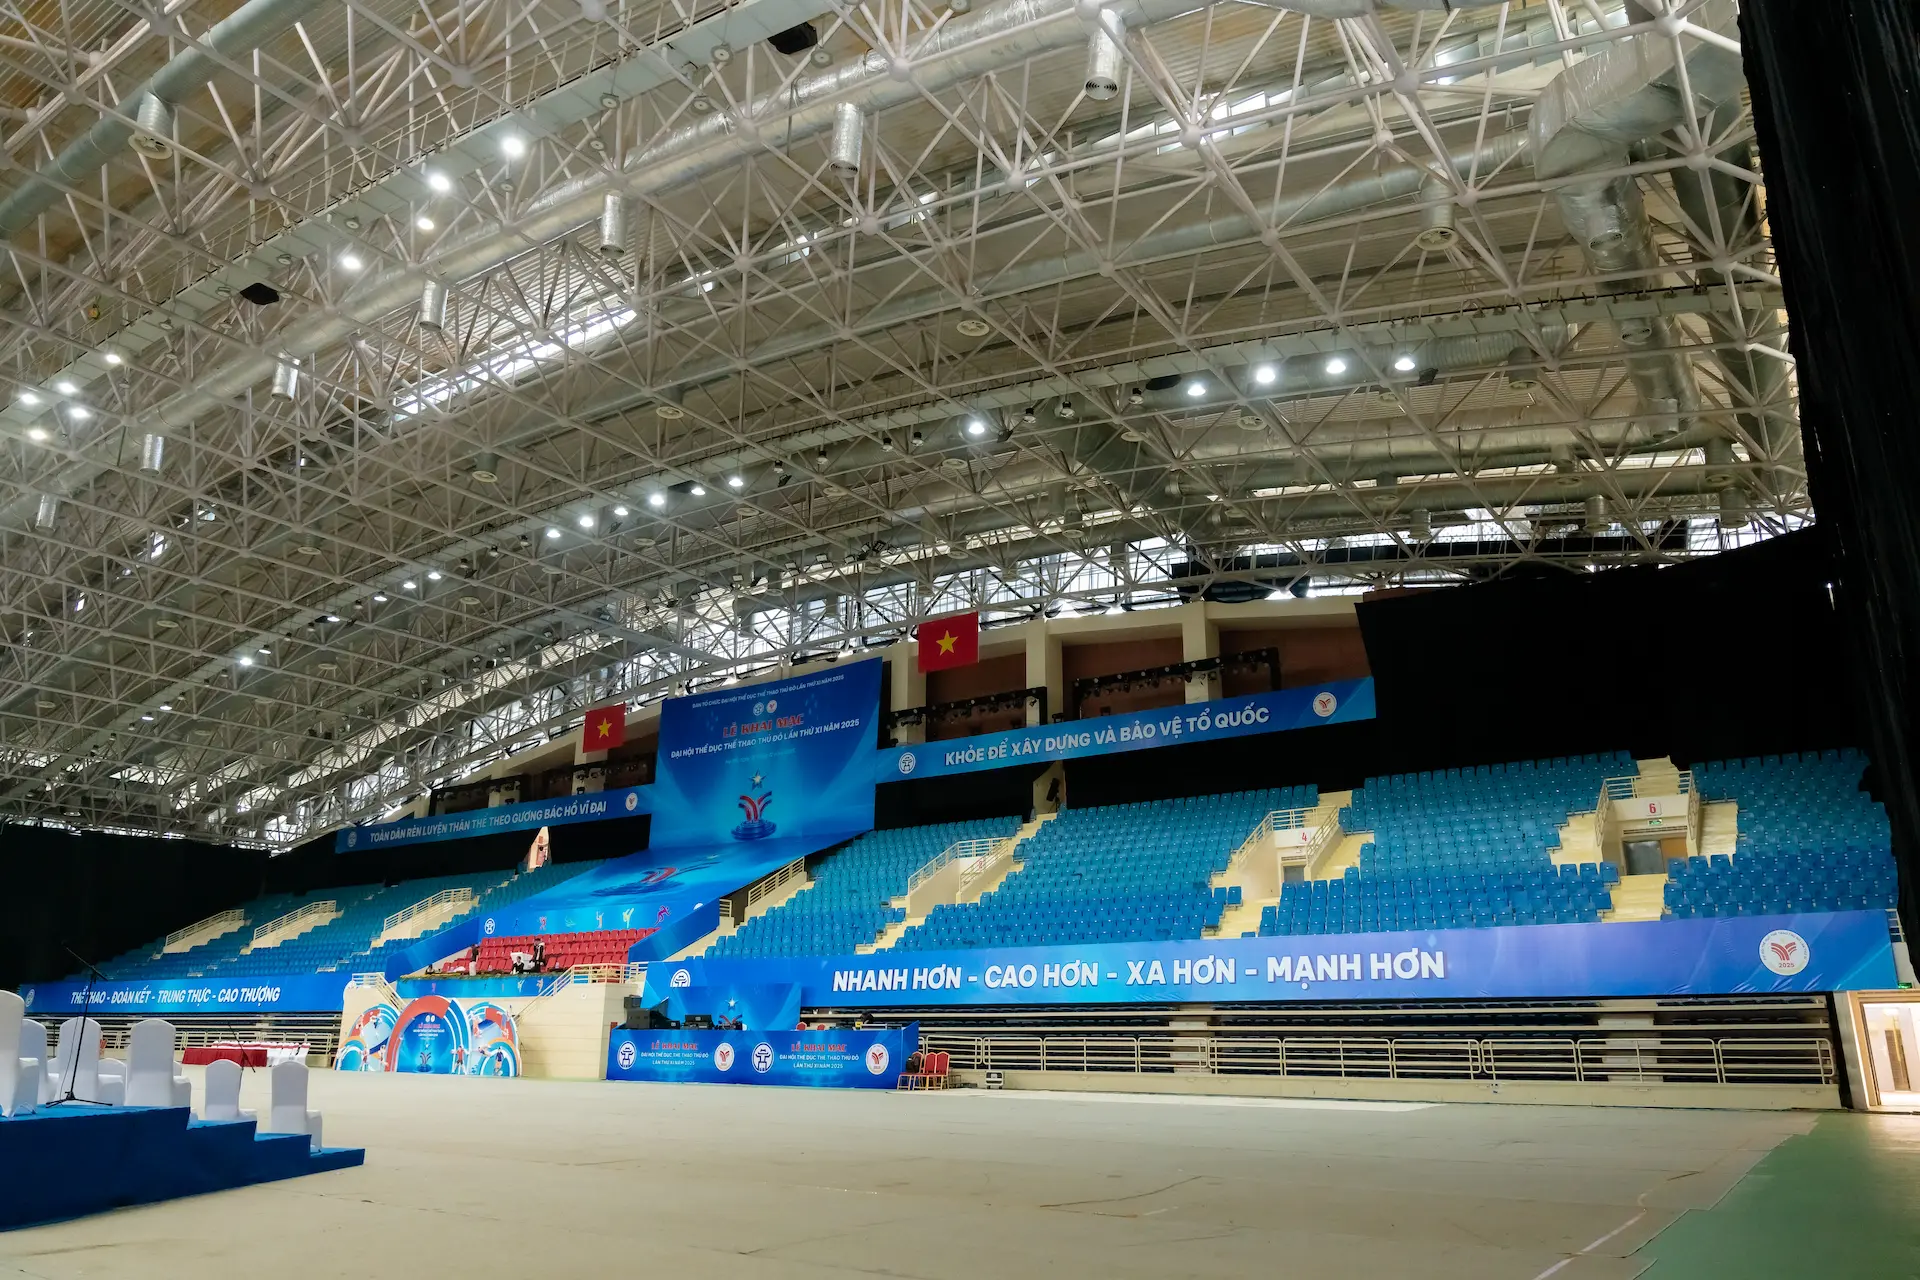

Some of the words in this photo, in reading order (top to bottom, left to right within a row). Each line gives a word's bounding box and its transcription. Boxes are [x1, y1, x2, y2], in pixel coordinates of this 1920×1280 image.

[723, 722, 737, 738] LỄ
[741, 720, 773, 735] KHAI
[776, 713, 804, 728] MẠC
[945, 744, 985, 766] KHỎE
[988, 737, 1008, 760] ĐỂ
[1012, 737, 1042, 756] XÂY
[1045, 733, 1090, 754] DỰNG
[1094, 725, 1116, 745] VÀ
[1120, 720, 1156, 742] BẢO
[1159, 716, 1182, 738] VỆ
[1186, 708, 1212, 732] TỔ
[1215, 702, 1270, 728] QUỐC
[370, 829, 390, 842] TOÀN
[390, 828, 406, 840] DÂN
[407, 825, 420, 838] RÈN
[422, 823, 448, 836] LUYỆN
[449, 818, 470, 832] THÂN
[472, 812, 488, 828] THỂ
[489, 814, 511, 827] THEO
[512, 810, 542, 823] GƯƠNG
[544, 804, 563, 819] BÁC
[564, 800, 578, 816] HỒ
[580, 800, 590, 814] VĨ
[590, 801, 606, 816] ĐẠI
[1649, 803, 1656, 814] 6
[1302, 832, 1307, 841] 4
[832, 968, 908, 992] NHANH
[912, 964, 961, 990] HƠN
[984, 964, 1037, 988] CAO
[1042, 960, 1098, 987] HƠN
[1126, 959, 1166, 986] XA
[1173, 955, 1235, 984] HƠN
[1267, 953, 1361, 990] MẠNH
[1370, 948, 1444, 980] HƠN
[111, 987, 135, 1004] ĐOÀN
[134, 985, 151, 1004] KẾT
[157, 989, 186, 1003] TRUNG
[187, 988, 211, 1006] THỰC
[218, 988, 238, 1002] CAO
[240, 986, 280, 1006] THƯỢNG
